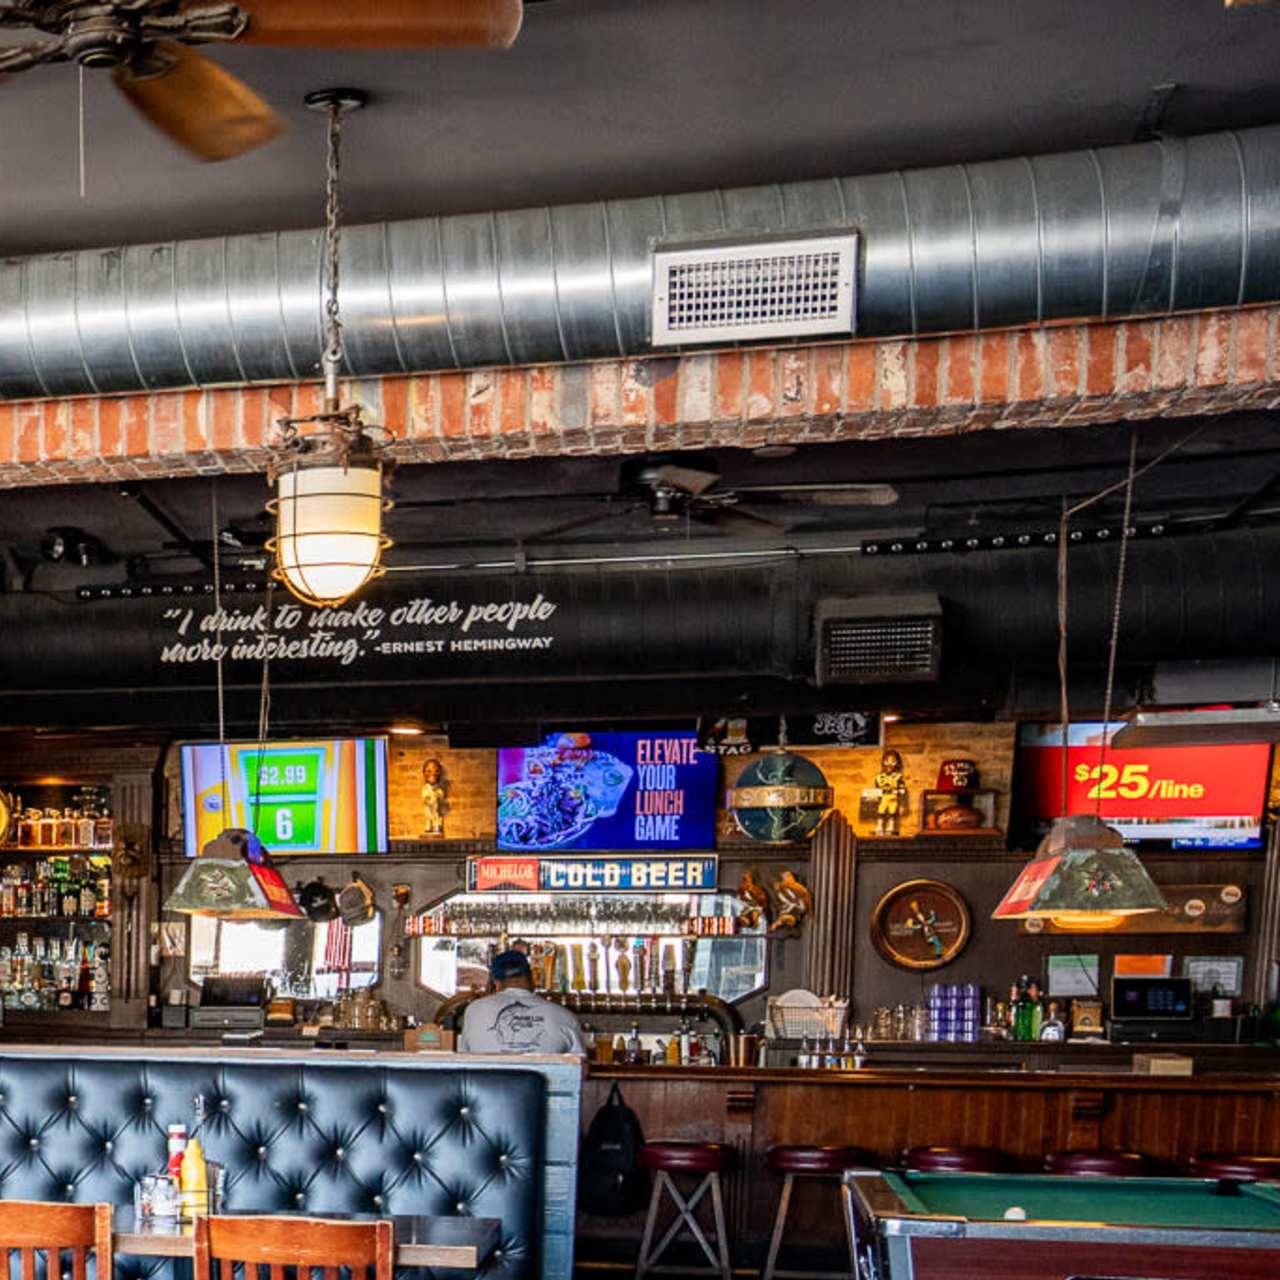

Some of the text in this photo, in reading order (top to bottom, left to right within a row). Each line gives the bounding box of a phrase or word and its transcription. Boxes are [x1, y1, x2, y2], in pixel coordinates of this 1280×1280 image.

[200, 605, 266, 633] drink
[275, 605, 302, 629] to
[308, 601, 384, 627] make
[390, 599, 462, 625] other
[461, 594, 557, 632] people
[161, 638, 227, 663] more
[451, 637, 553, 652] HEMINGWAY
[637, 739, 697, 764] ELEVATE
[259, 765, 306, 785] $2.99
[637, 765, 676, 790] YOUR
[1075, 764, 1204, 799] $25/line
[636, 790, 684, 815] LUNCH
[275, 808, 293, 840] 6
[635, 815, 679, 840] GAME
[481, 863, 534, 880] MICHELOB
